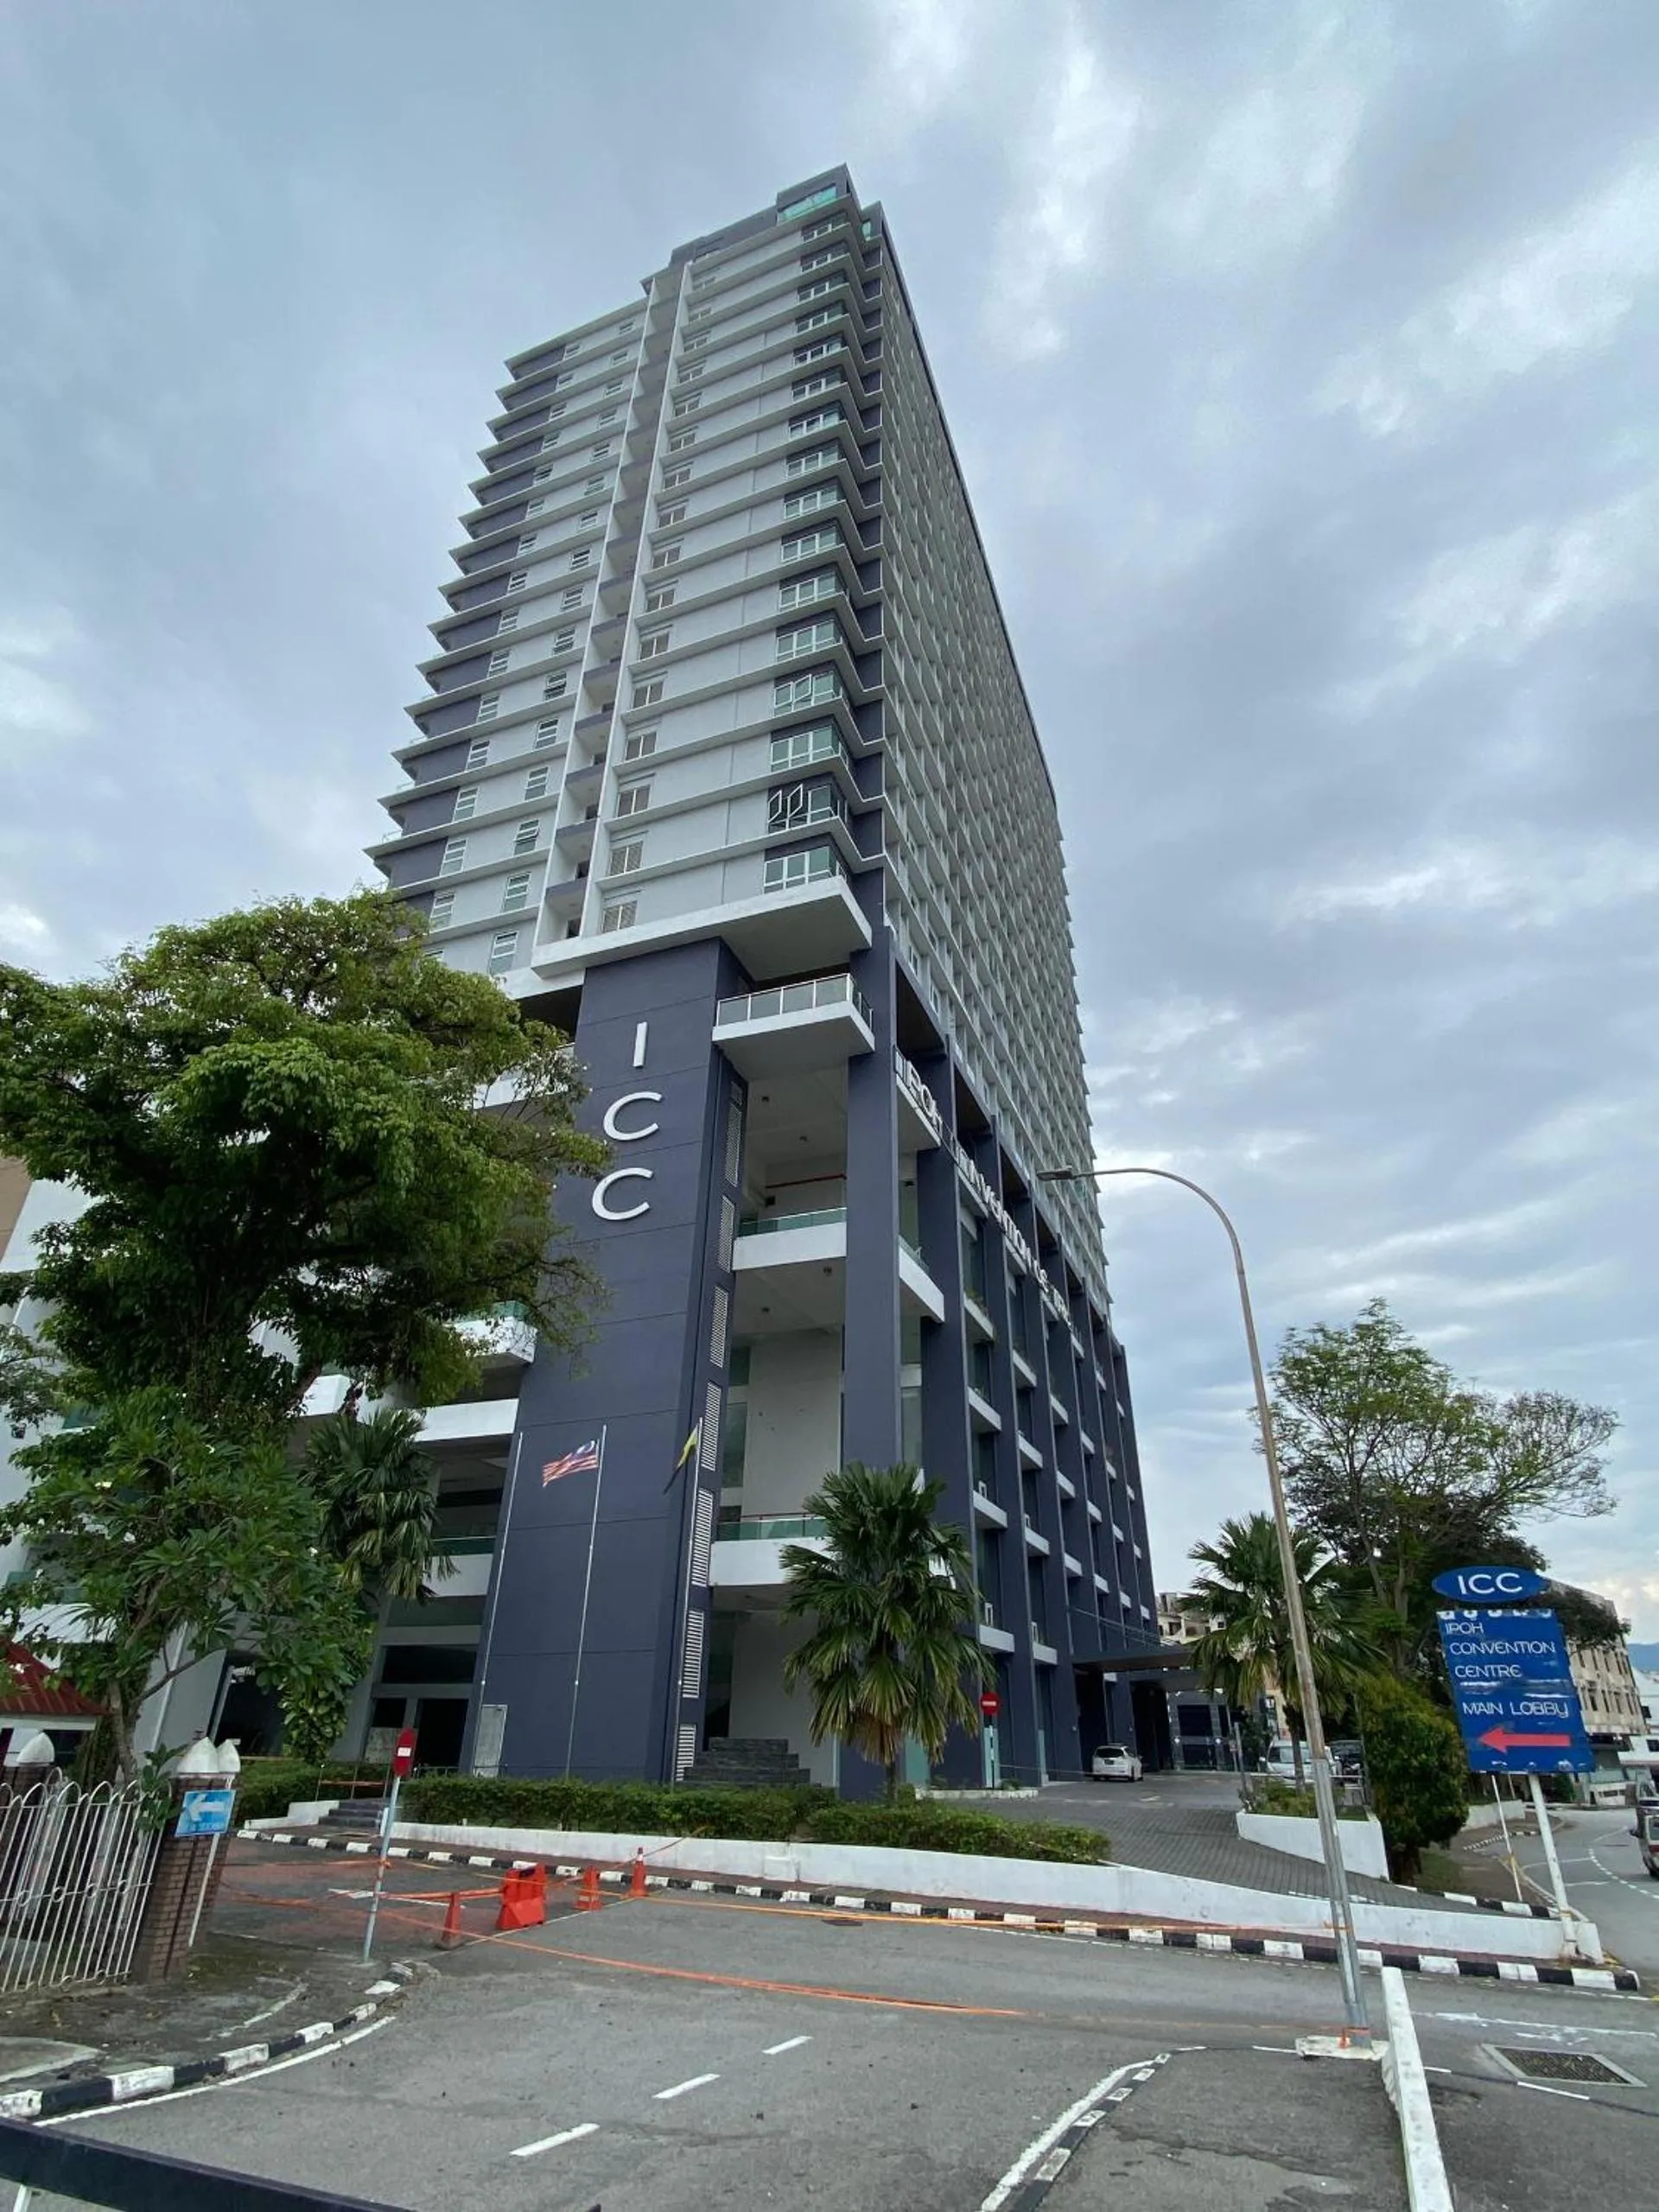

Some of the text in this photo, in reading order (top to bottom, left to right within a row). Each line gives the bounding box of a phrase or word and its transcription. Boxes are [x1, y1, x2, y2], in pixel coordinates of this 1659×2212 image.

[591, 1021, 663, 1222] ICC
[1457, 1573, 1522, 1595] ICC
[1445, 1621, 1484, 1635] IPOH
[1449, 1640, 1556, 1655] CONVENTION
[1454, 1663, 1522, 1678] CENTRE
[1462, 1700, 1569, 1719] MAIN LOBBY
